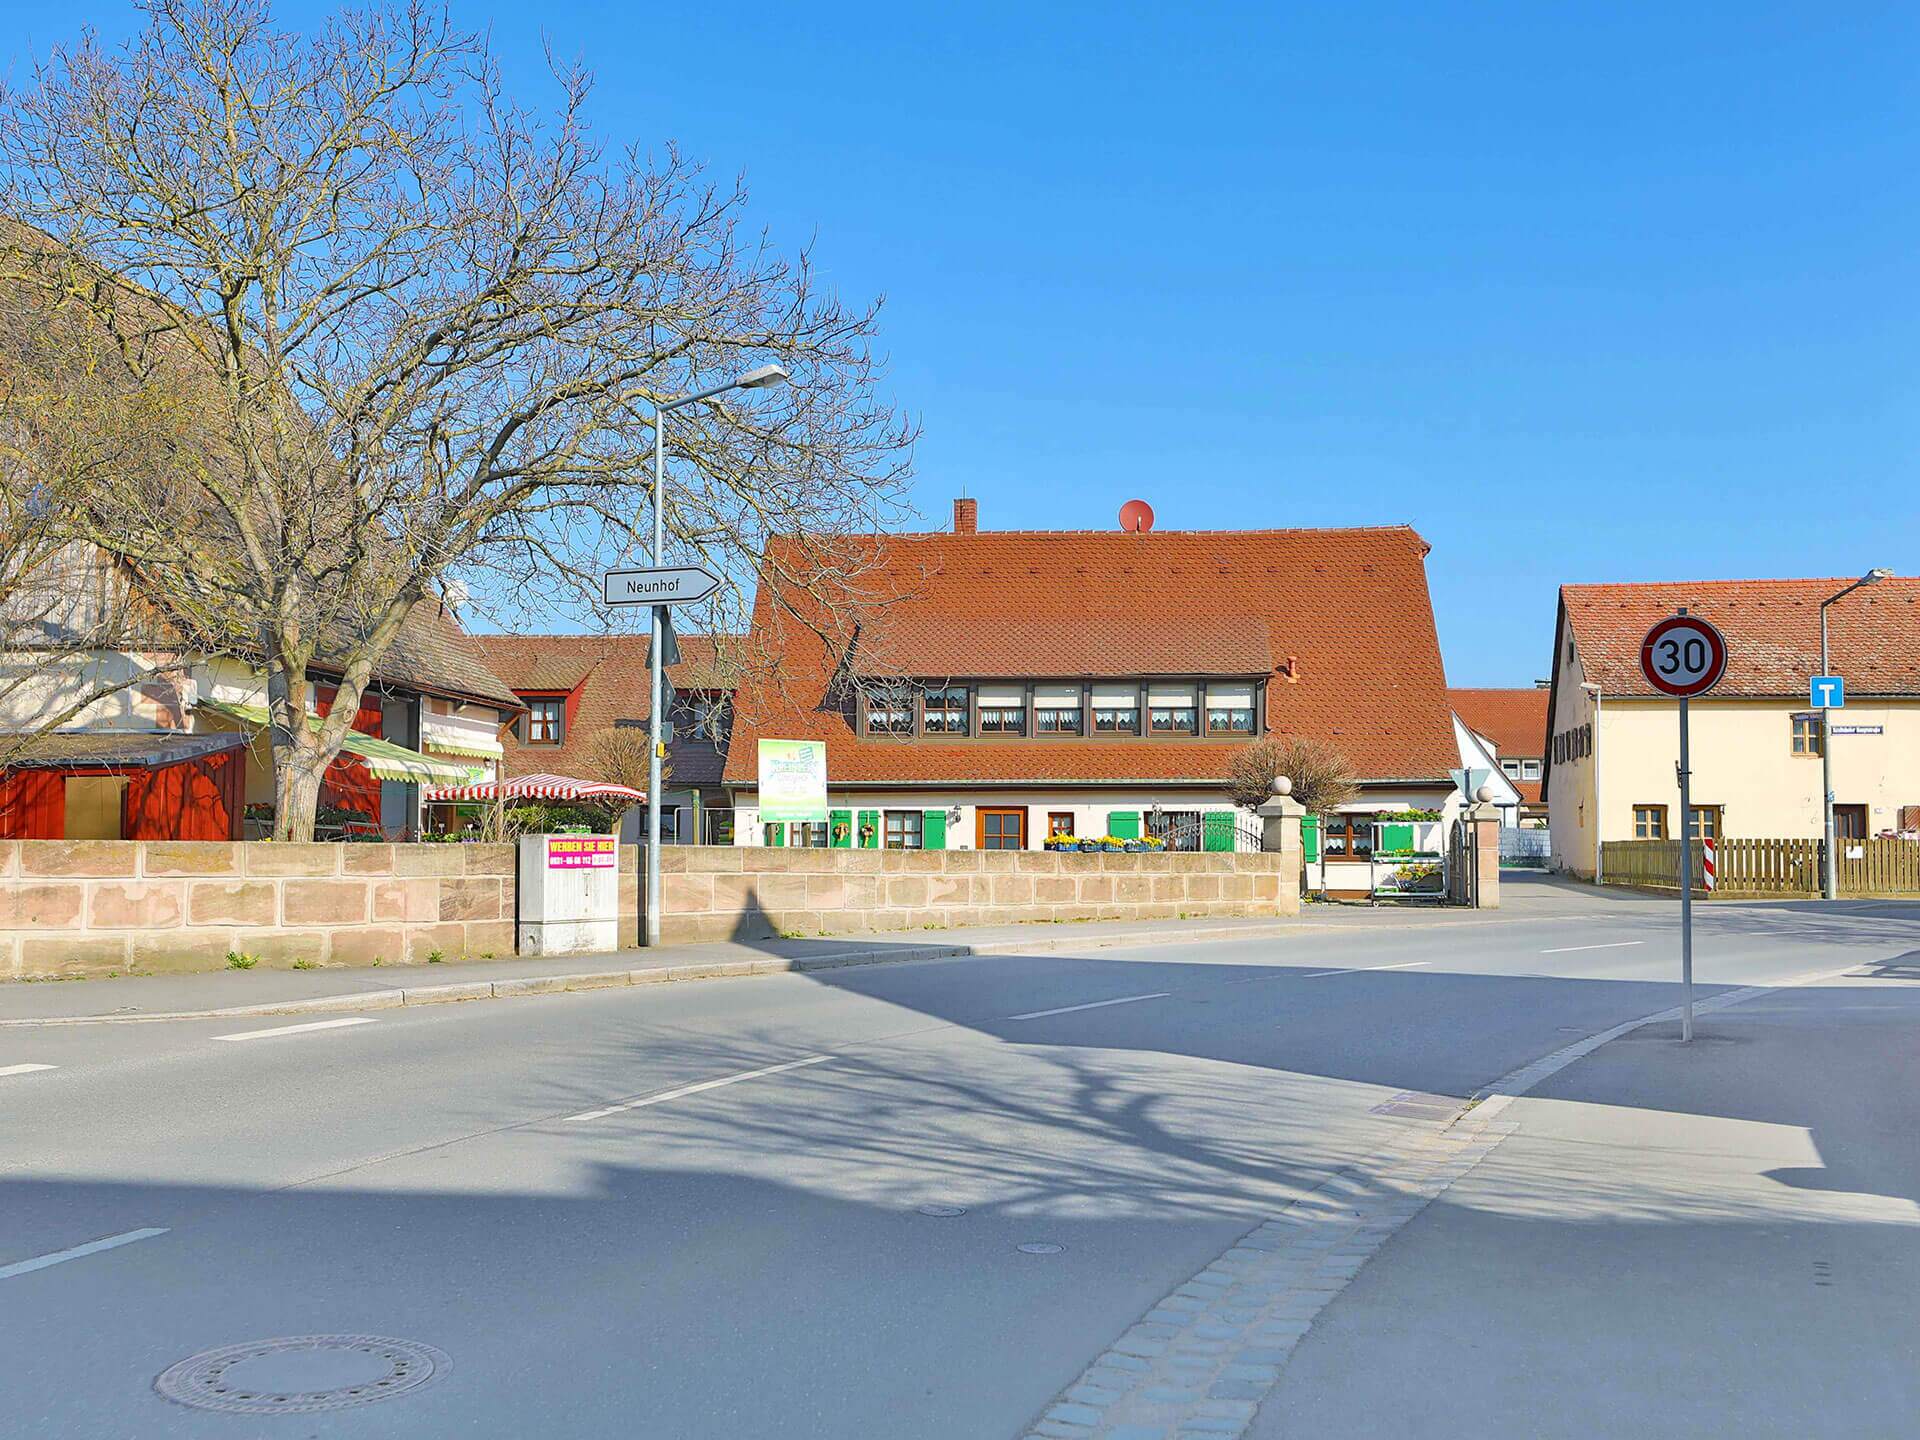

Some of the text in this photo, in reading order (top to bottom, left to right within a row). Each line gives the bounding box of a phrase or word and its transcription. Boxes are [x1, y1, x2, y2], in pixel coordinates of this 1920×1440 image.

[627, 577, 681, 594] Neunhof
[1658, 638, 1706, 675] 30
[550, 841, 614, 853] WERBEN SIE HIER
